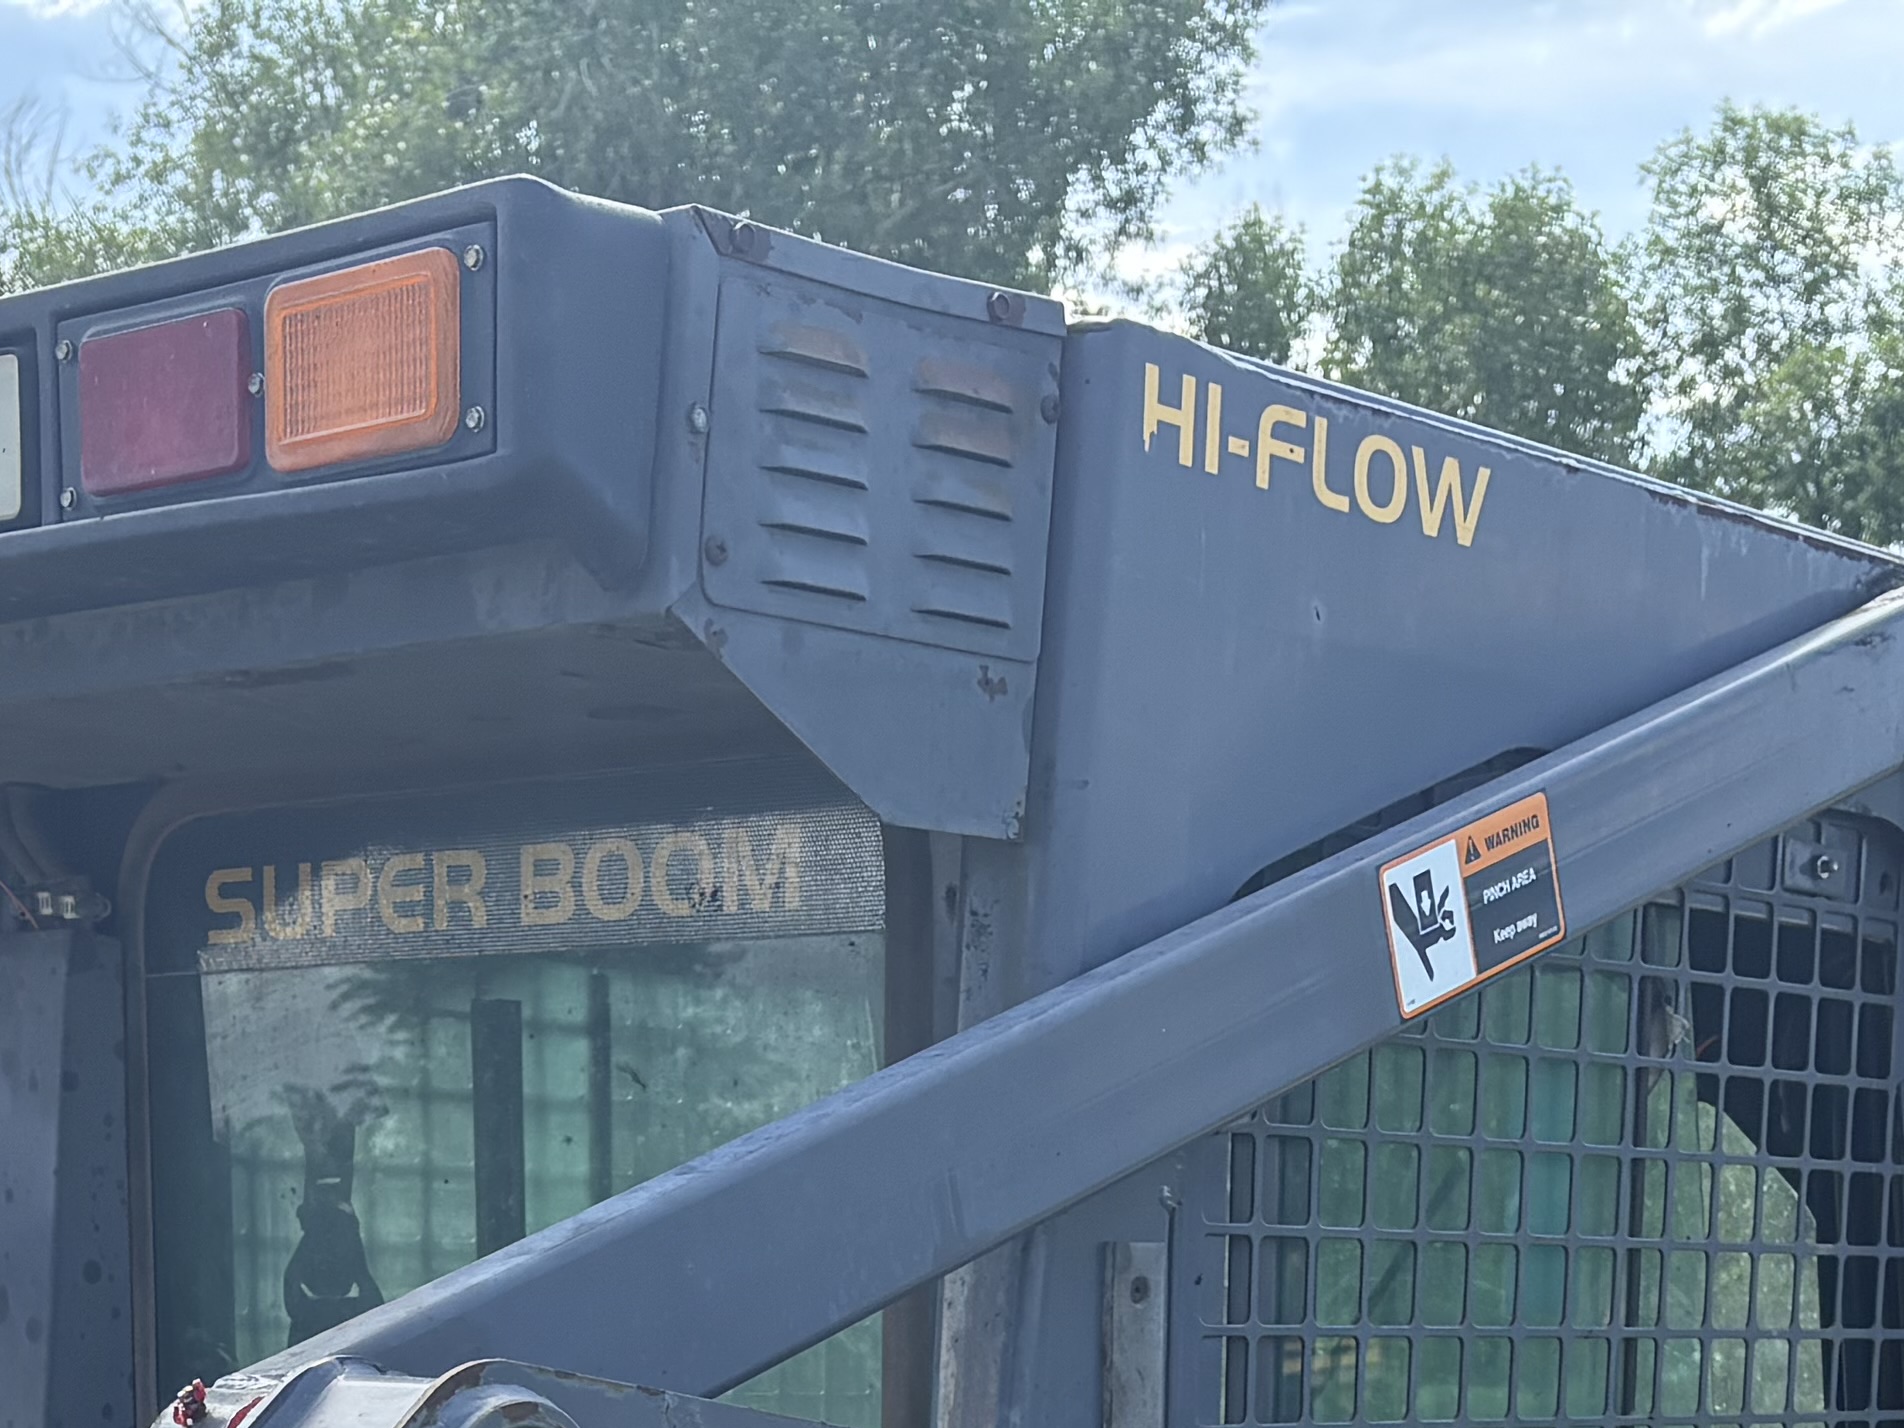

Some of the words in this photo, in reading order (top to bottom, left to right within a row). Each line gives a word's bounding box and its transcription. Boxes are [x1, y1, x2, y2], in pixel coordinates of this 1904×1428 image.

[1143, 362, 1491, 547] HI-FLOW
[1484, 814, 1540, 852] WARNING
[205, 848, 488, 944] SUPER
[519, 822, 801, 926] BOOM
[1482, 879, 1510, 904] PINCH
[1511, 867, 1537, 892] AREA
[1493, 921, 1516, 943] Keep
